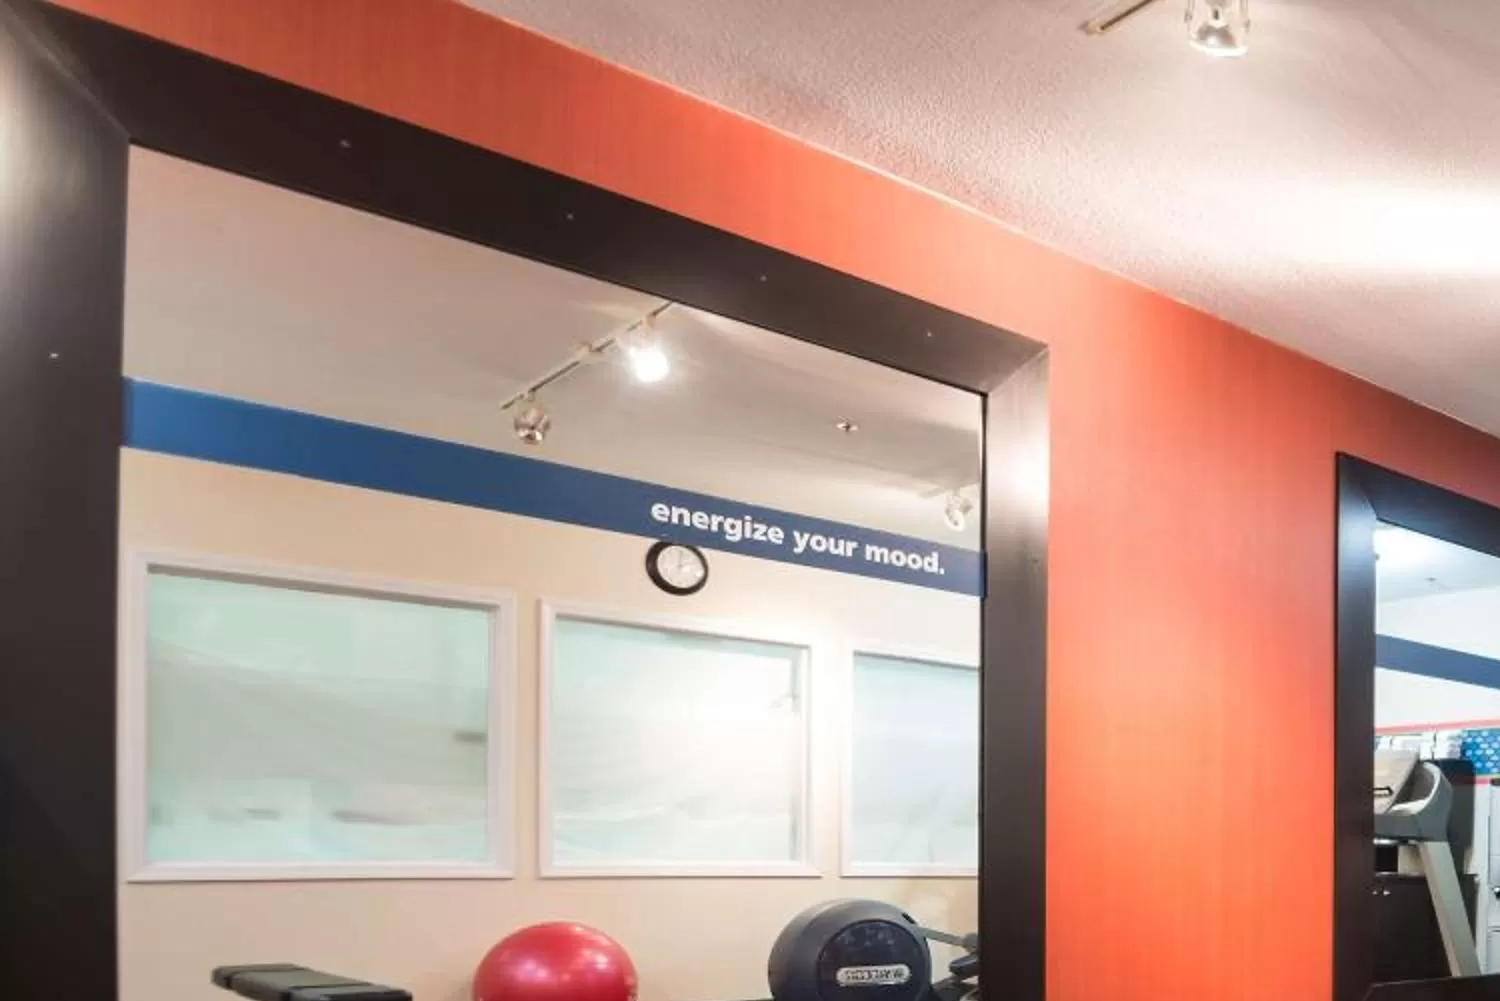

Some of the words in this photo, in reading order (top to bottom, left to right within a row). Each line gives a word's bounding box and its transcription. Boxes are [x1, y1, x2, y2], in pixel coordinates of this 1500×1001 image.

[651, 503, 785, 544] energize
[793, 530, 858, 557] your
[865, 543, 945, 575] mood.
